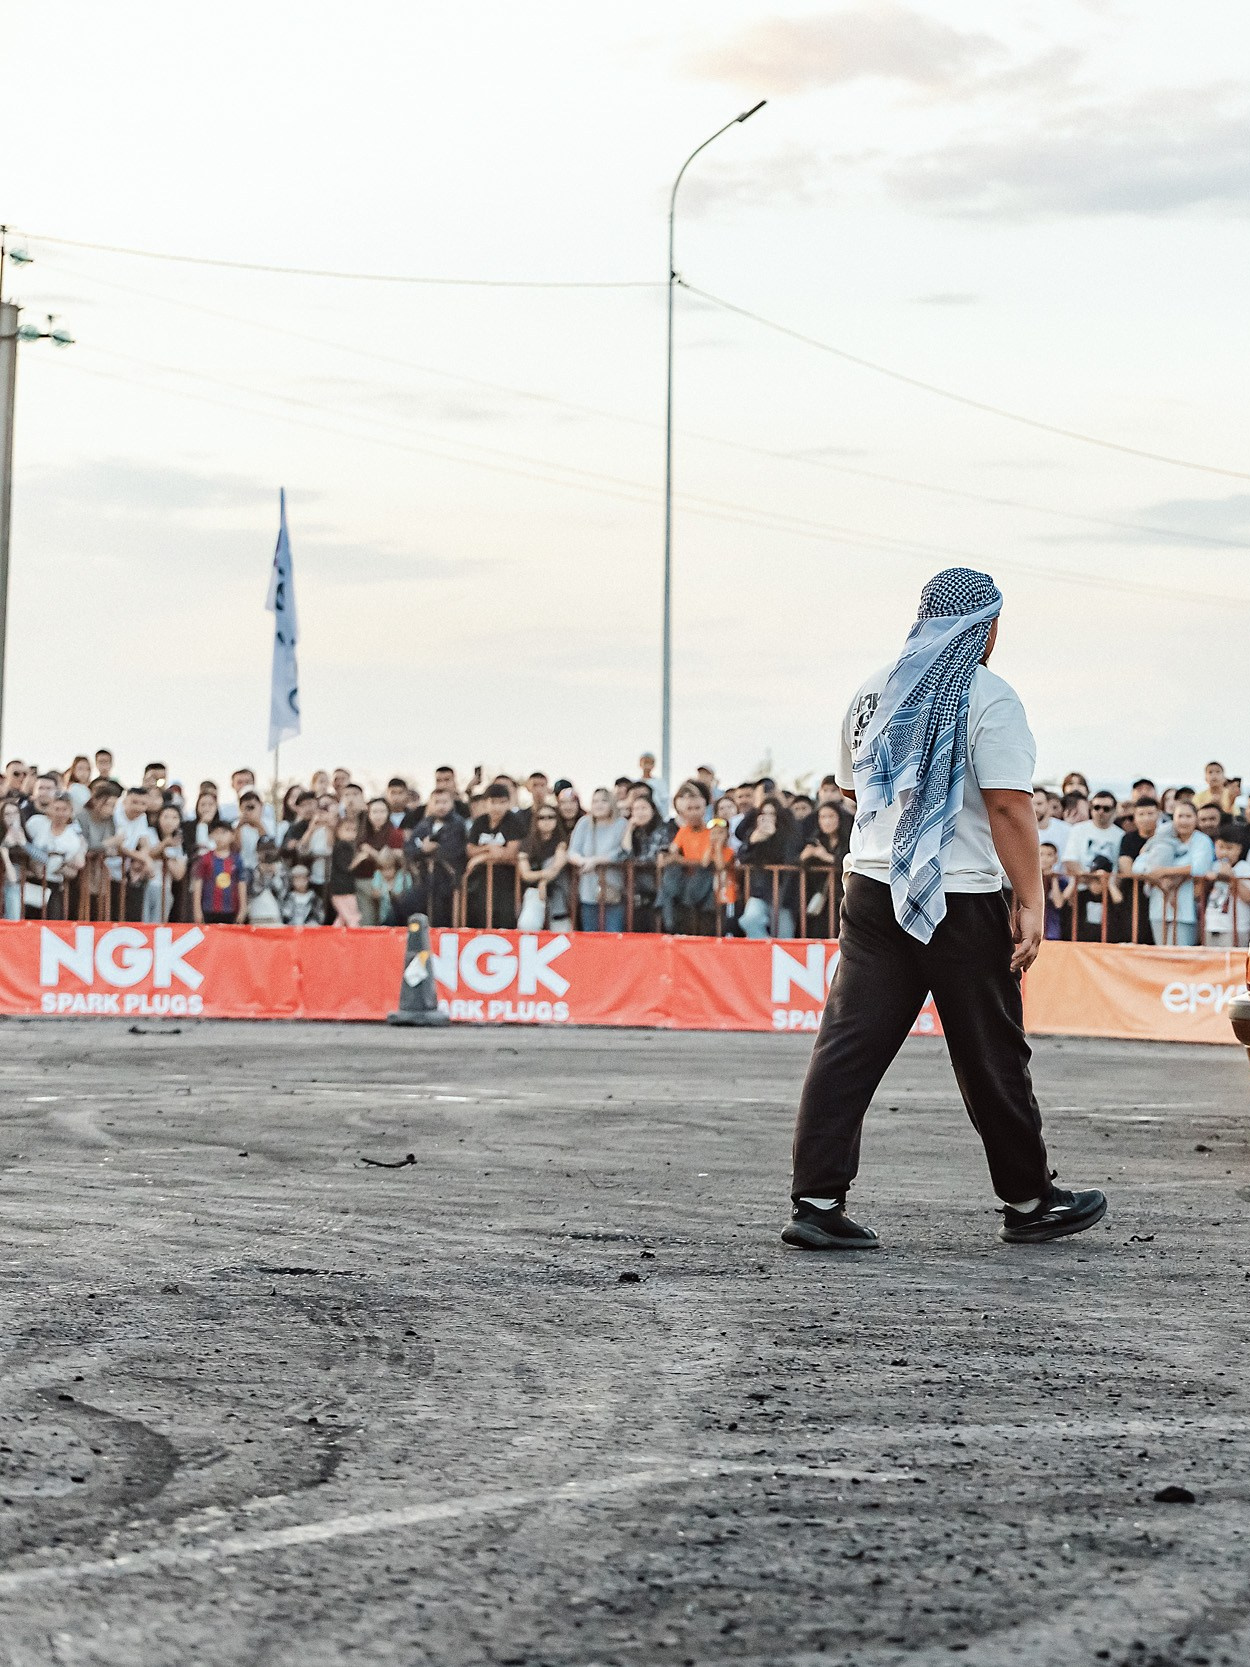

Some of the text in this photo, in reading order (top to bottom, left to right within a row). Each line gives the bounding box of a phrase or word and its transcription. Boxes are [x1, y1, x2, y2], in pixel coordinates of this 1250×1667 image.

[40, 925, 206, 990] NGK
[41, 992, 203, 1015] SPARK PLUGS
[488, 1000, 570, 1022] PLUGS
[772, 1009, 823, 1030] SPA
